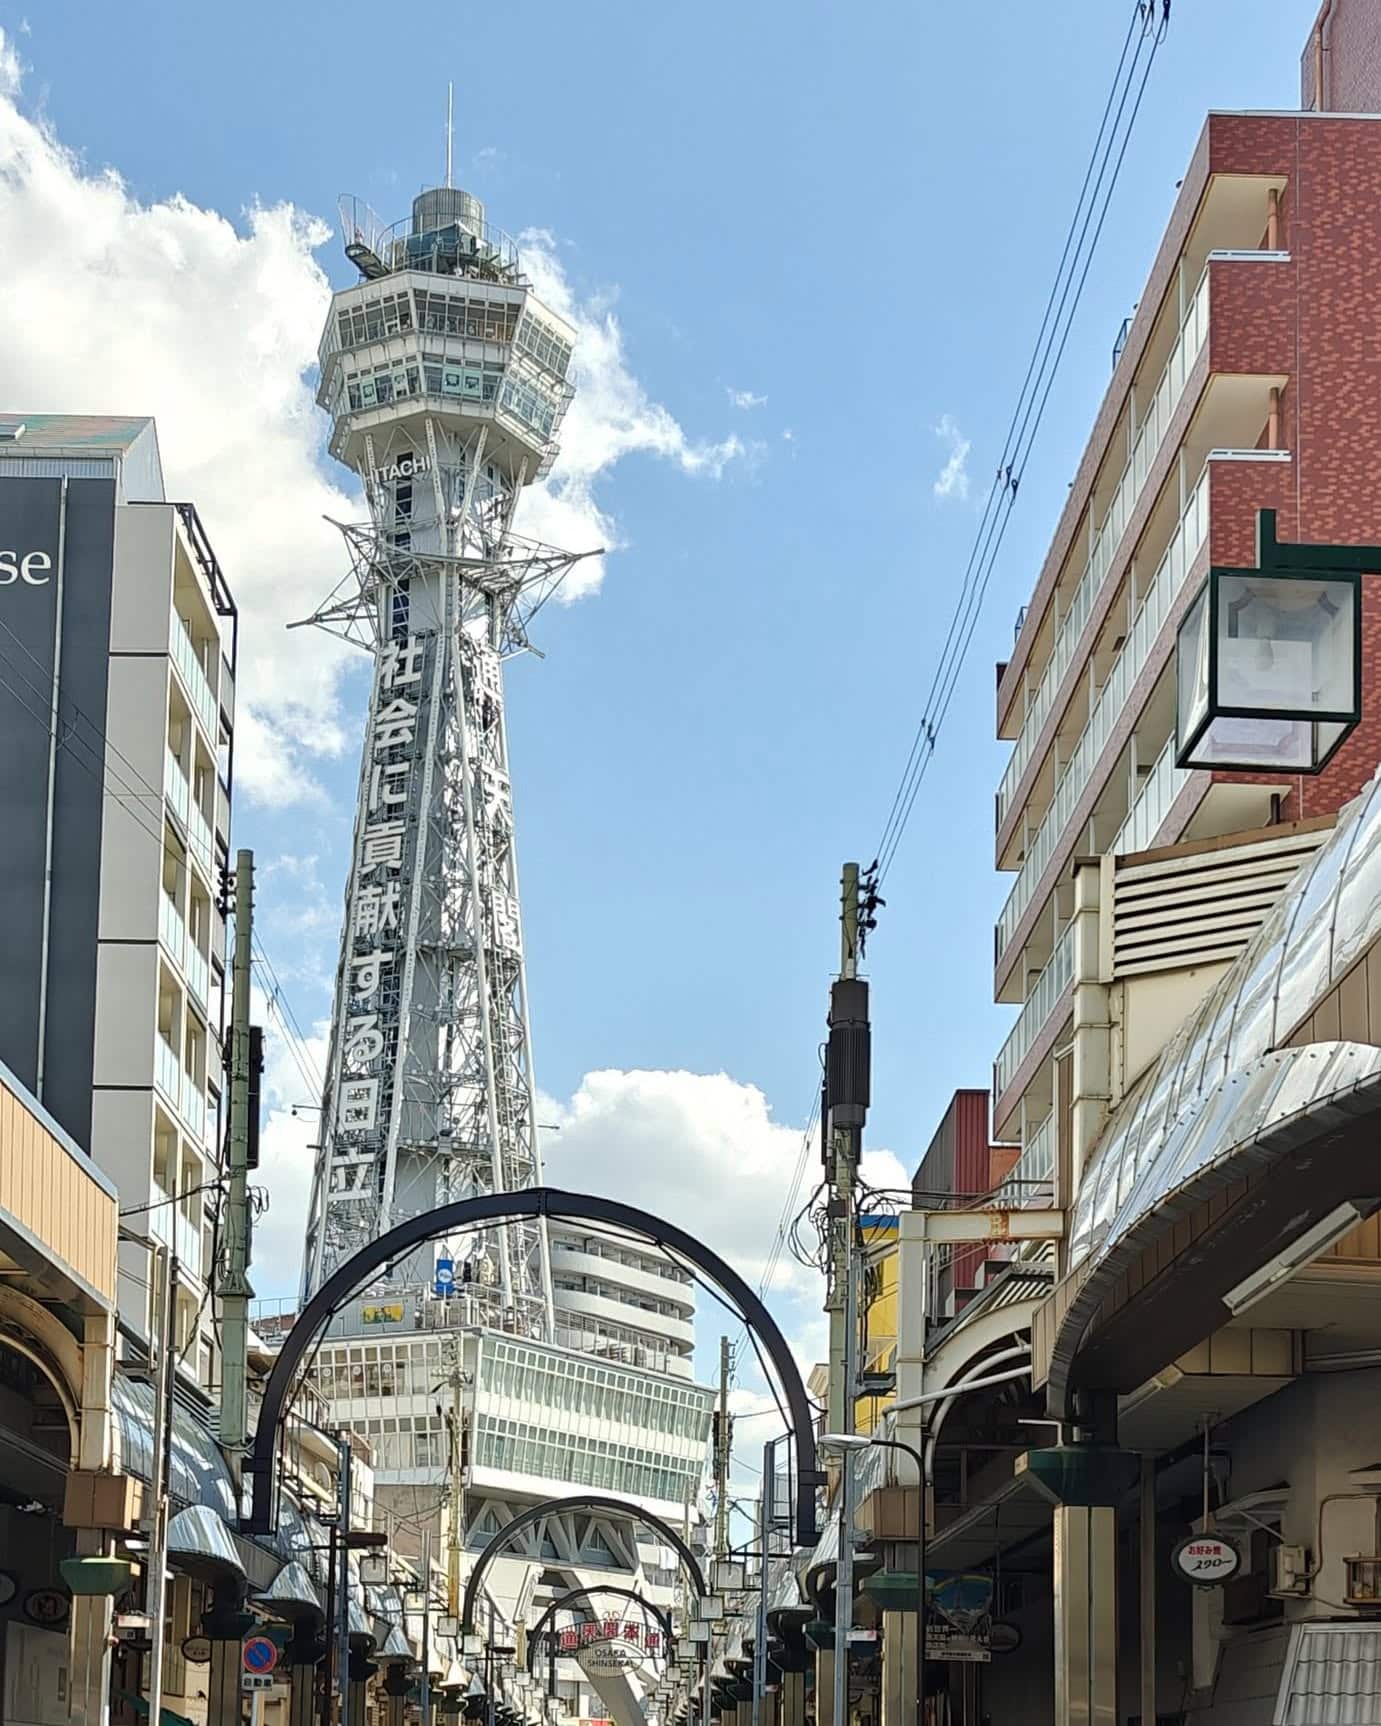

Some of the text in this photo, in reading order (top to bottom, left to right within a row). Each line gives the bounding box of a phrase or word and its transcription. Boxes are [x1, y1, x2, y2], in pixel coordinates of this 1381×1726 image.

[328, 639, 424, 1202] 社会に貢献する日立
[475, 648, 524, 958] 通天閣
[595, 1649, 627, 1658] OSAKA
